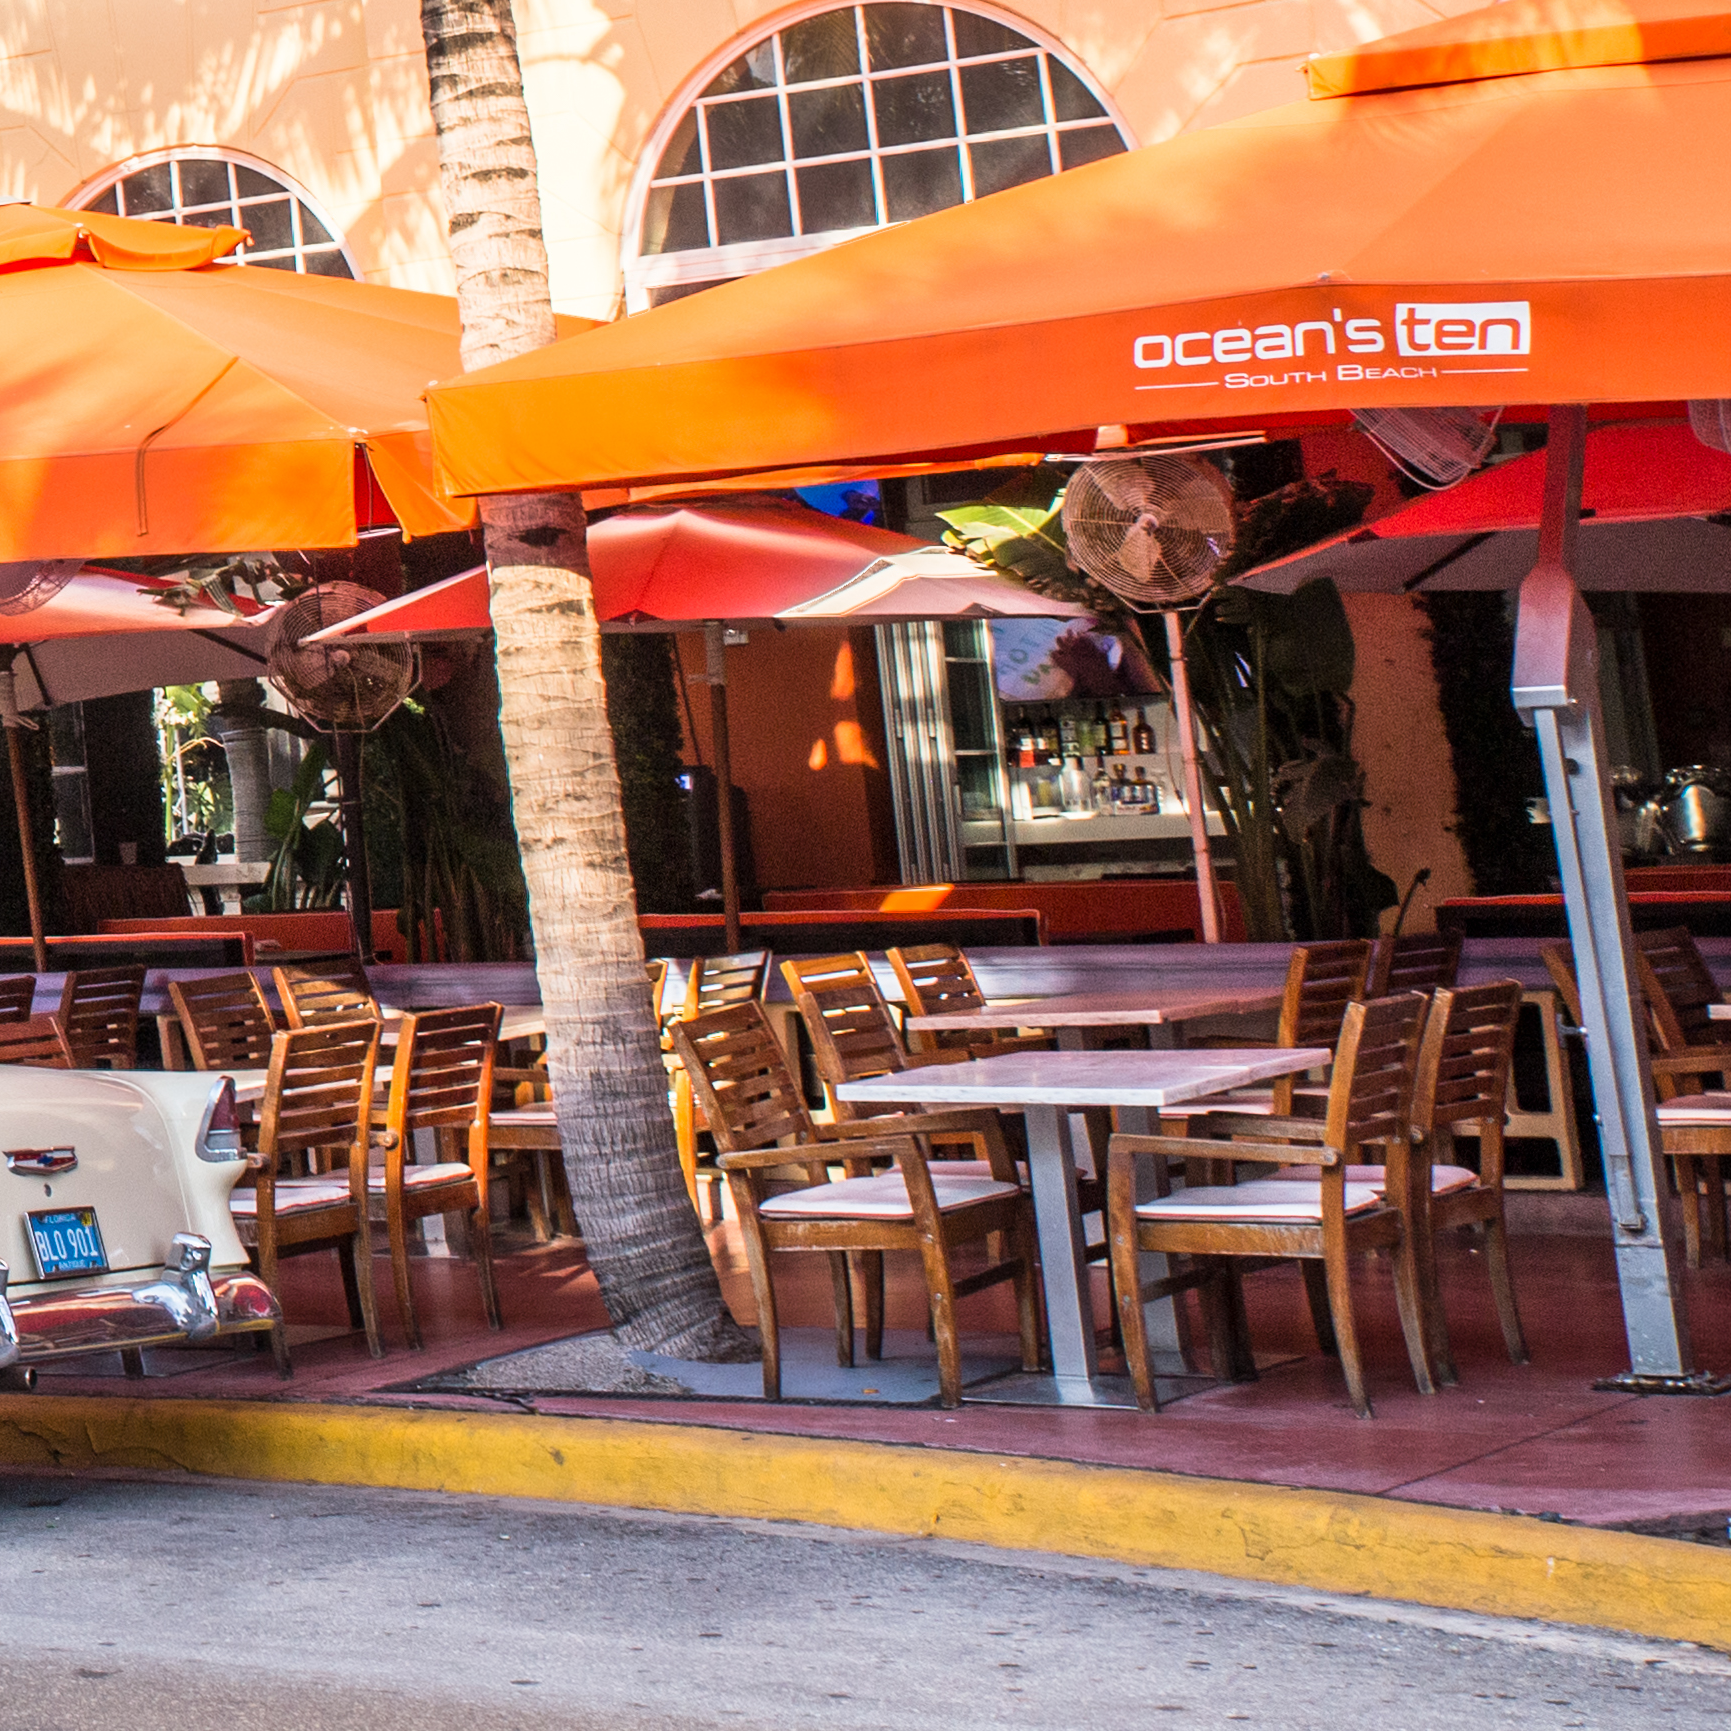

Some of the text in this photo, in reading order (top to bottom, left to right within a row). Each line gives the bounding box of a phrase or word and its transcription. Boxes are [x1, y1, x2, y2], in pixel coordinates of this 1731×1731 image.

[1134, 304, 1526, 368] ocean's ten
[67, 1226, 98, 1258] 901
